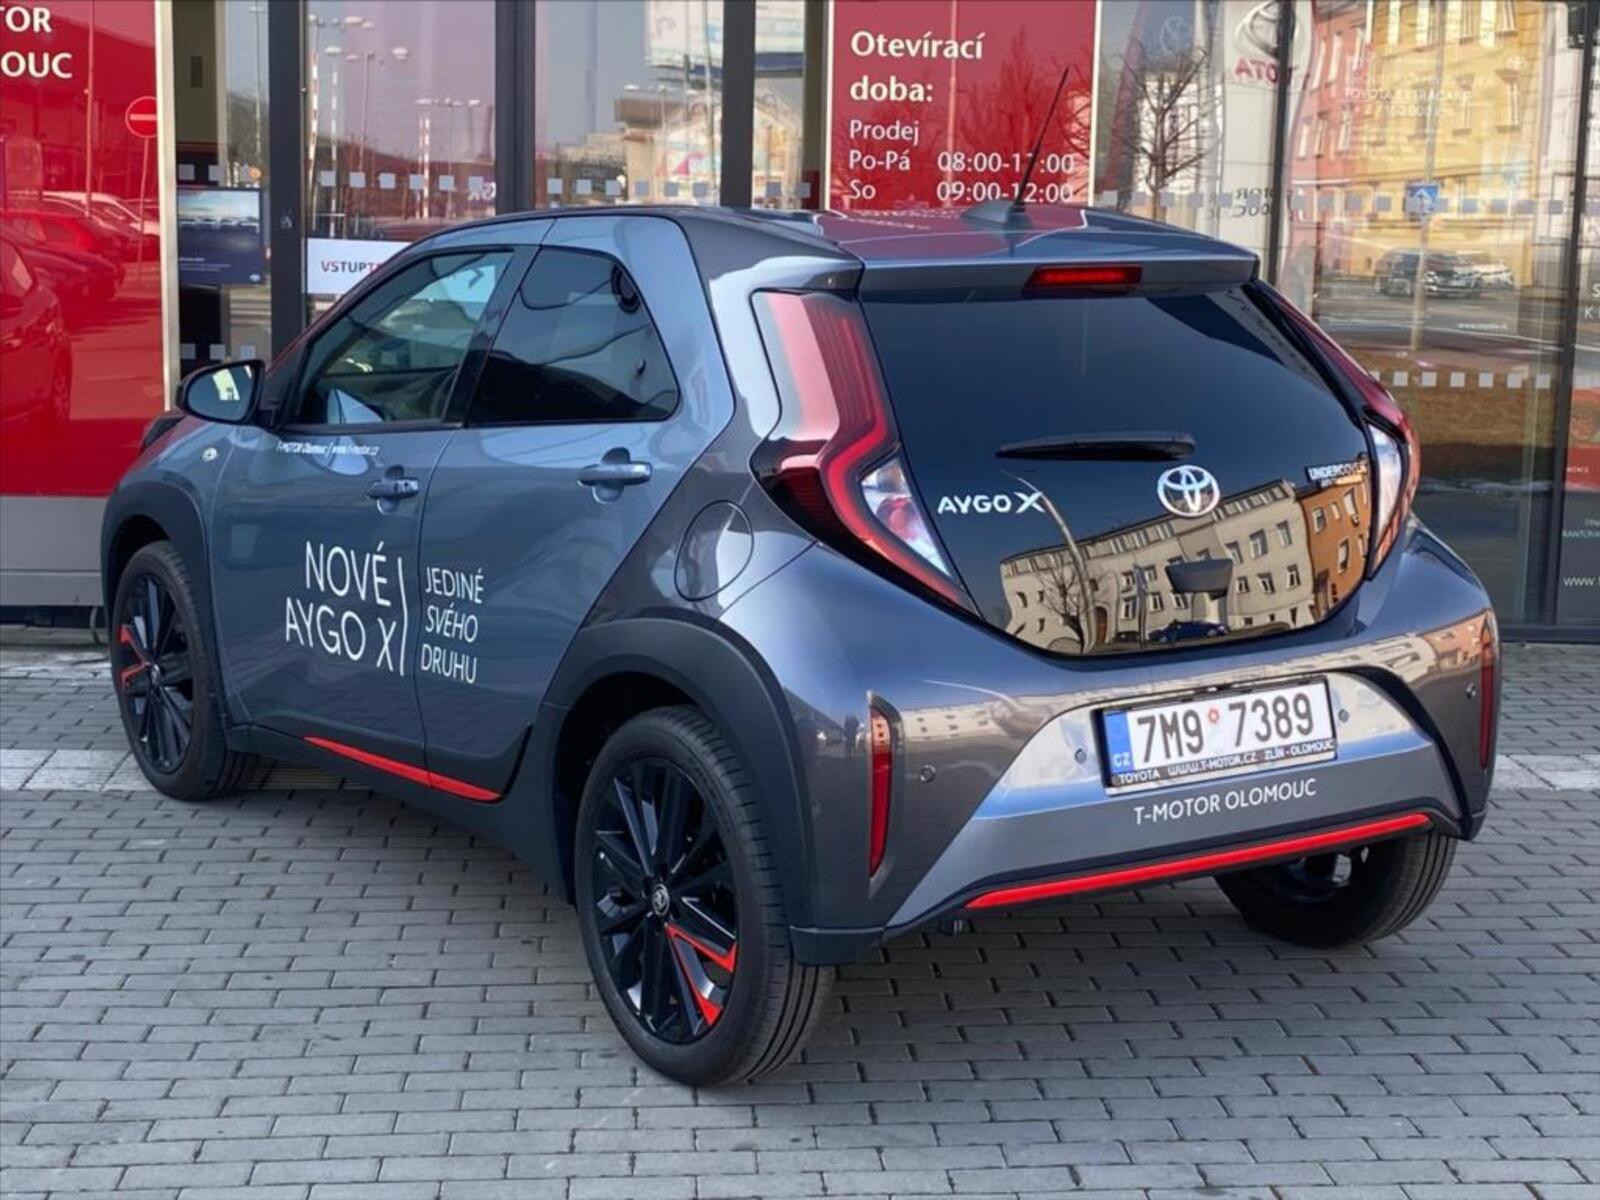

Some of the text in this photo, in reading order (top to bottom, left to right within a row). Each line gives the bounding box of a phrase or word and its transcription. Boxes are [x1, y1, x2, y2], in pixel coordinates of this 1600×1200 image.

[850, 29, 986, 59] Otevírací
[849, 75, 934, 102] doba:
[850, 119, 920, 146] Prodej
[849, 149, 1075, 174] Po-Pá 08:00-1:00
[850, 179, 1074, 202] So 09:00-12:00
[937, 491, 1046, 514] AYGO X
[305, 540, 391, 607] NOVÉ
[425, 566, 484, 604] JEDINÉ
[285, 596, 397, 672] AYGO X
[424, 602, 478, 643] SVÉHO
[420, 643, 477, 684] DRUHU
[1137, 692, 1314, 763] 7M9 7389
[1113, 752, 1131, 767] CZ
[1118, 769, 1161, 784] TOYOTA
[1290, 739, 1335, 756] OLOMOUC
[1134, 778, 1317, 825] T-MOTOR OLOMOUC
